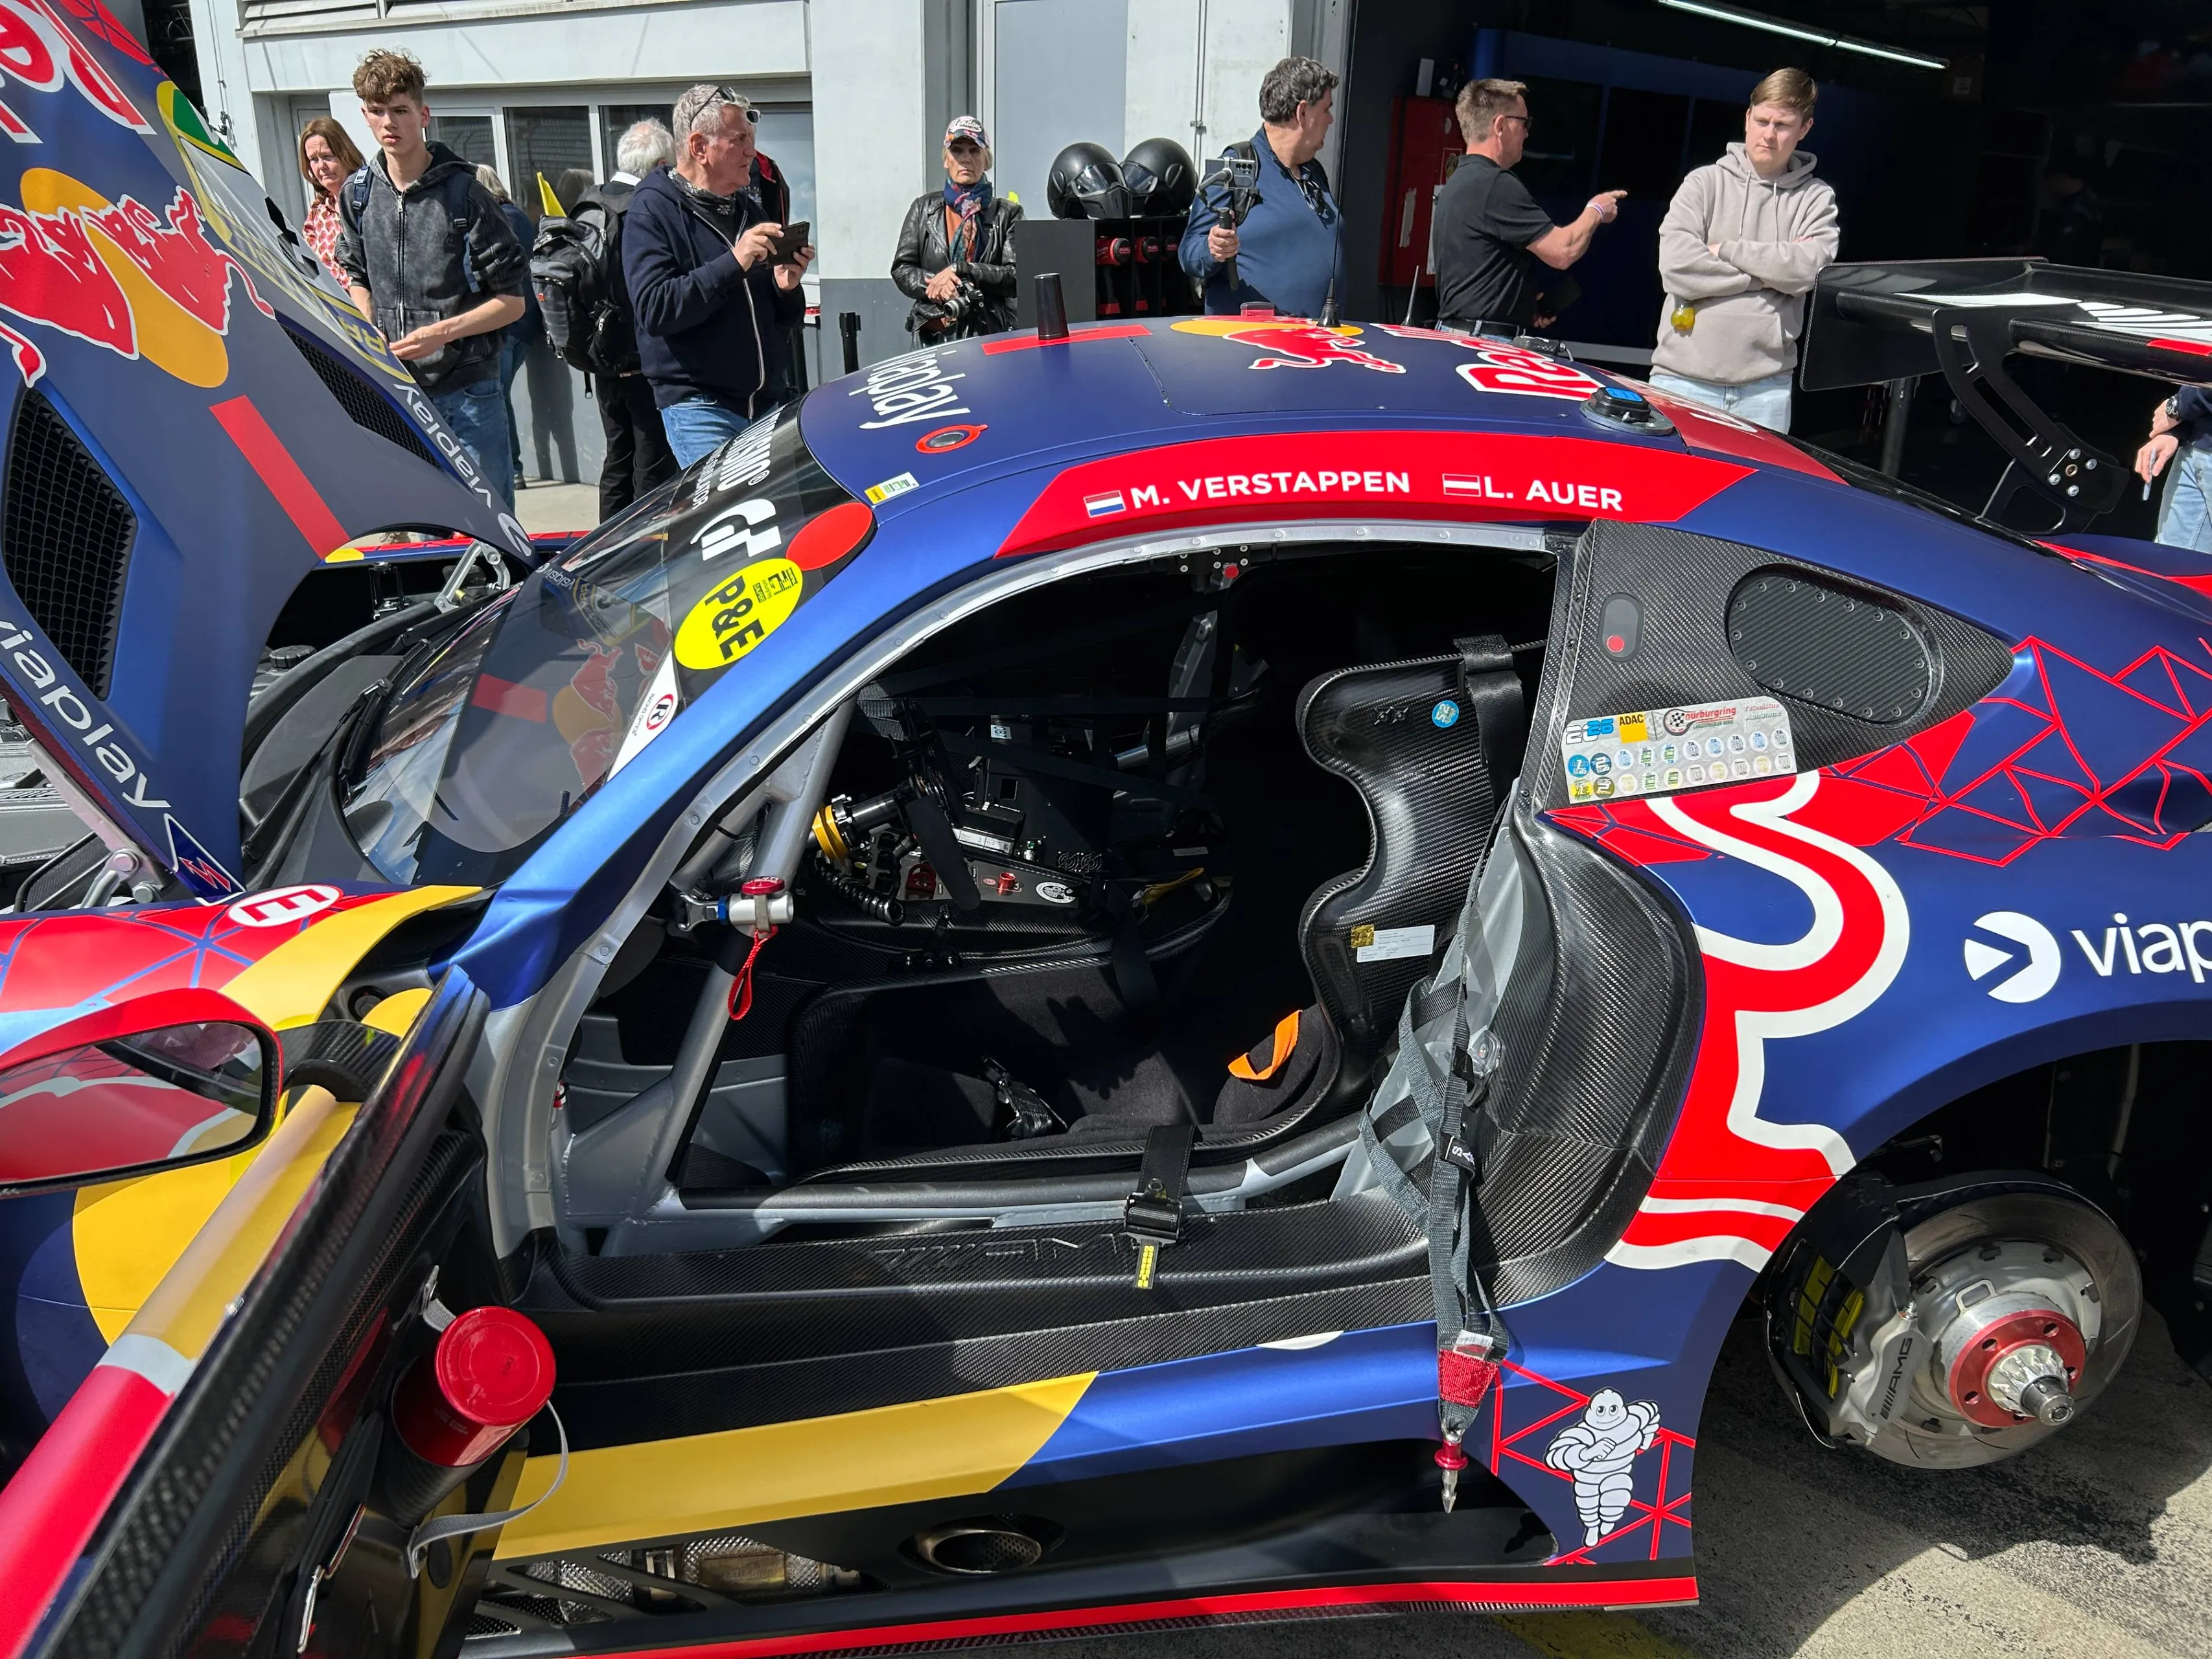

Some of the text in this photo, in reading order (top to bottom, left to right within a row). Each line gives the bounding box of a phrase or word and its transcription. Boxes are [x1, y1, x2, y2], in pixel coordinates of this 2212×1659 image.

[393, 384, 491, 509] viaplay
[1130, 471, 1410, 510] M. VERSTAPPEN
[1484, 476, 1624, 511] L. AUER
[704, 575, 765, 660] P&E
[1619, 714, 1644, 726] ADAC
